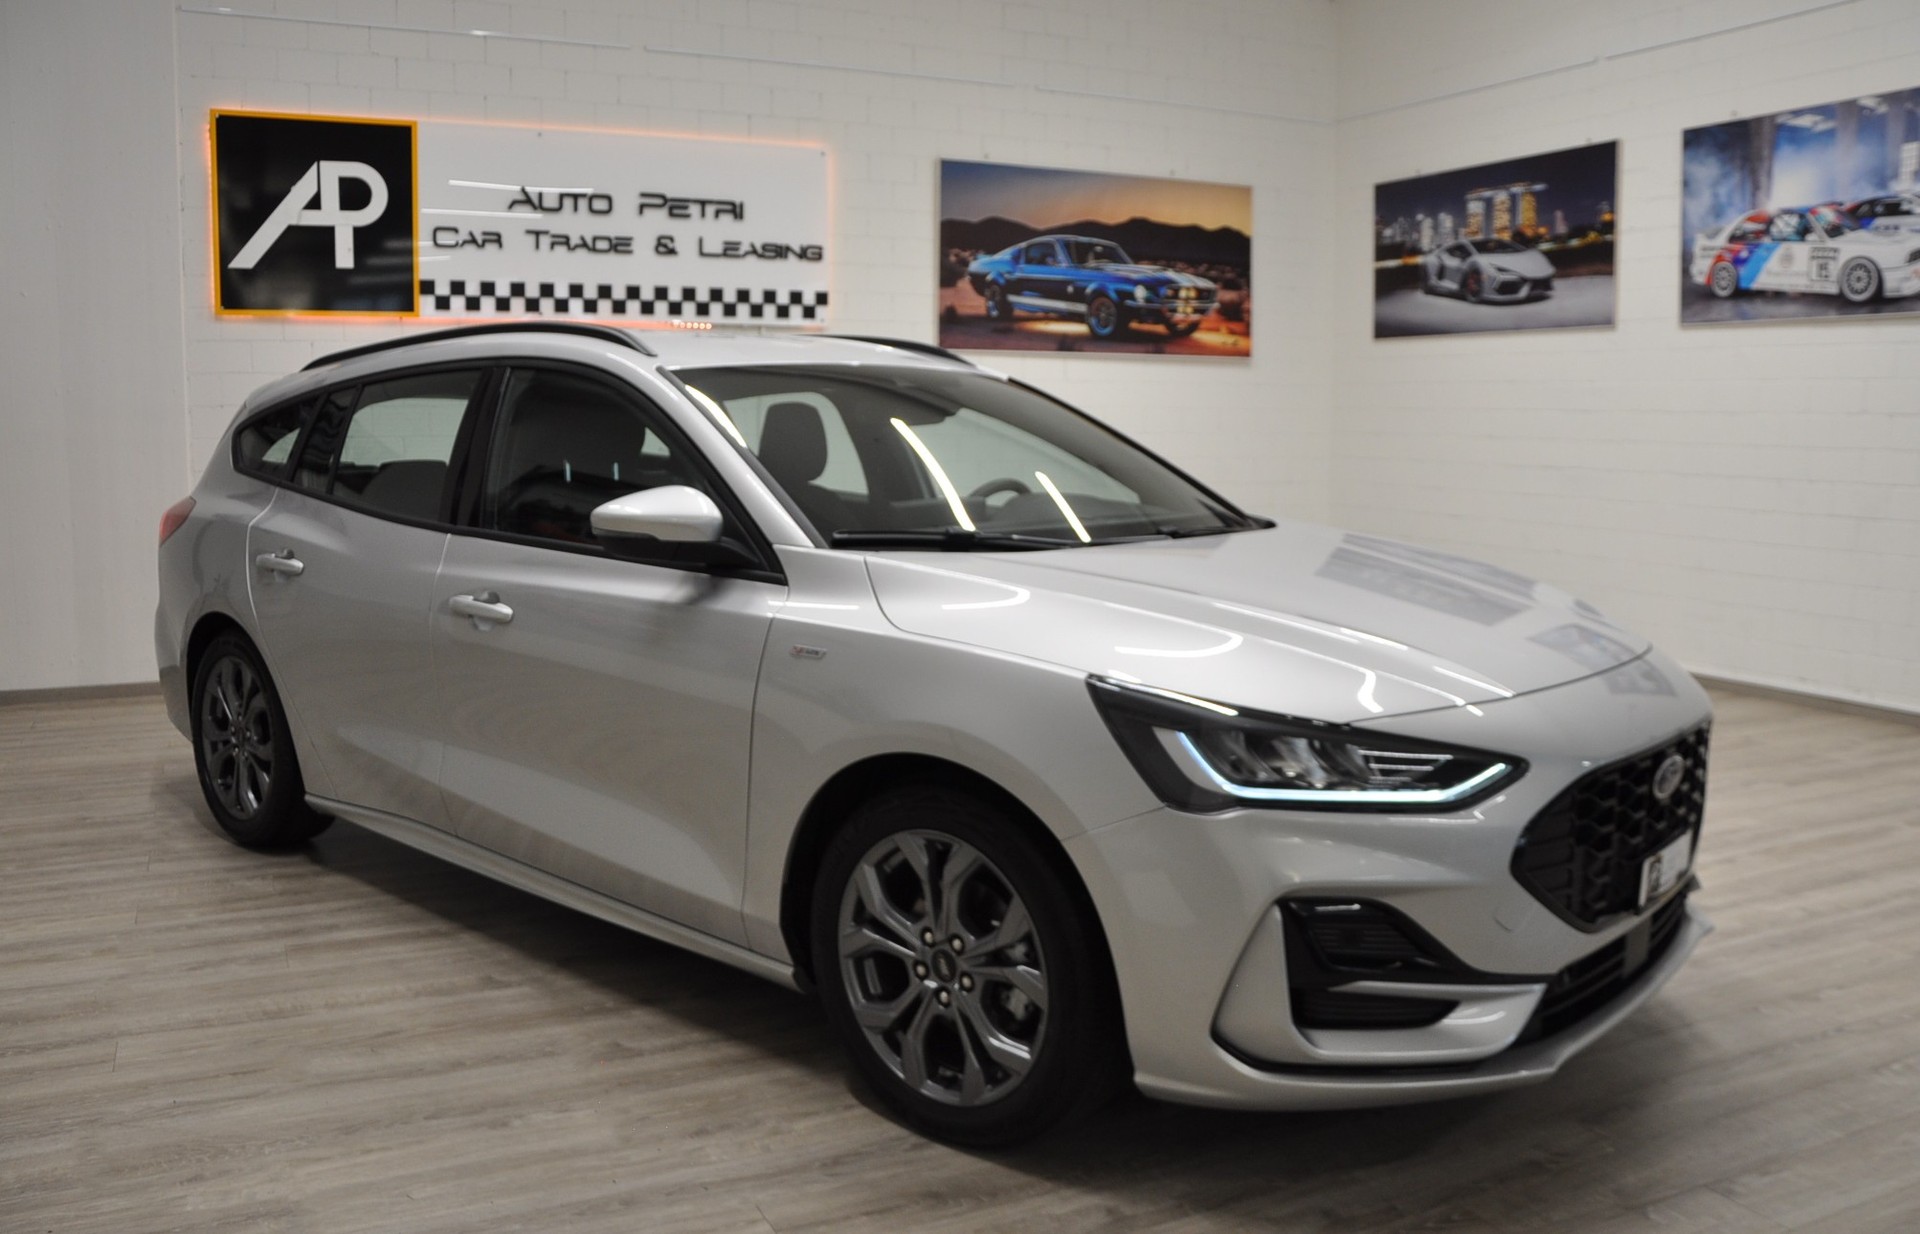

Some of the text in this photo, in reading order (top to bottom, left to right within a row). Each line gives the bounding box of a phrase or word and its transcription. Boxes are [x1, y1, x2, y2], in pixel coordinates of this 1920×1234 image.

[228, 160, 388, 269] AP
[508, 186, 744, 221] AUTO PETRI
[432, 226, 823, 261] CAR TRADE & LEASING
